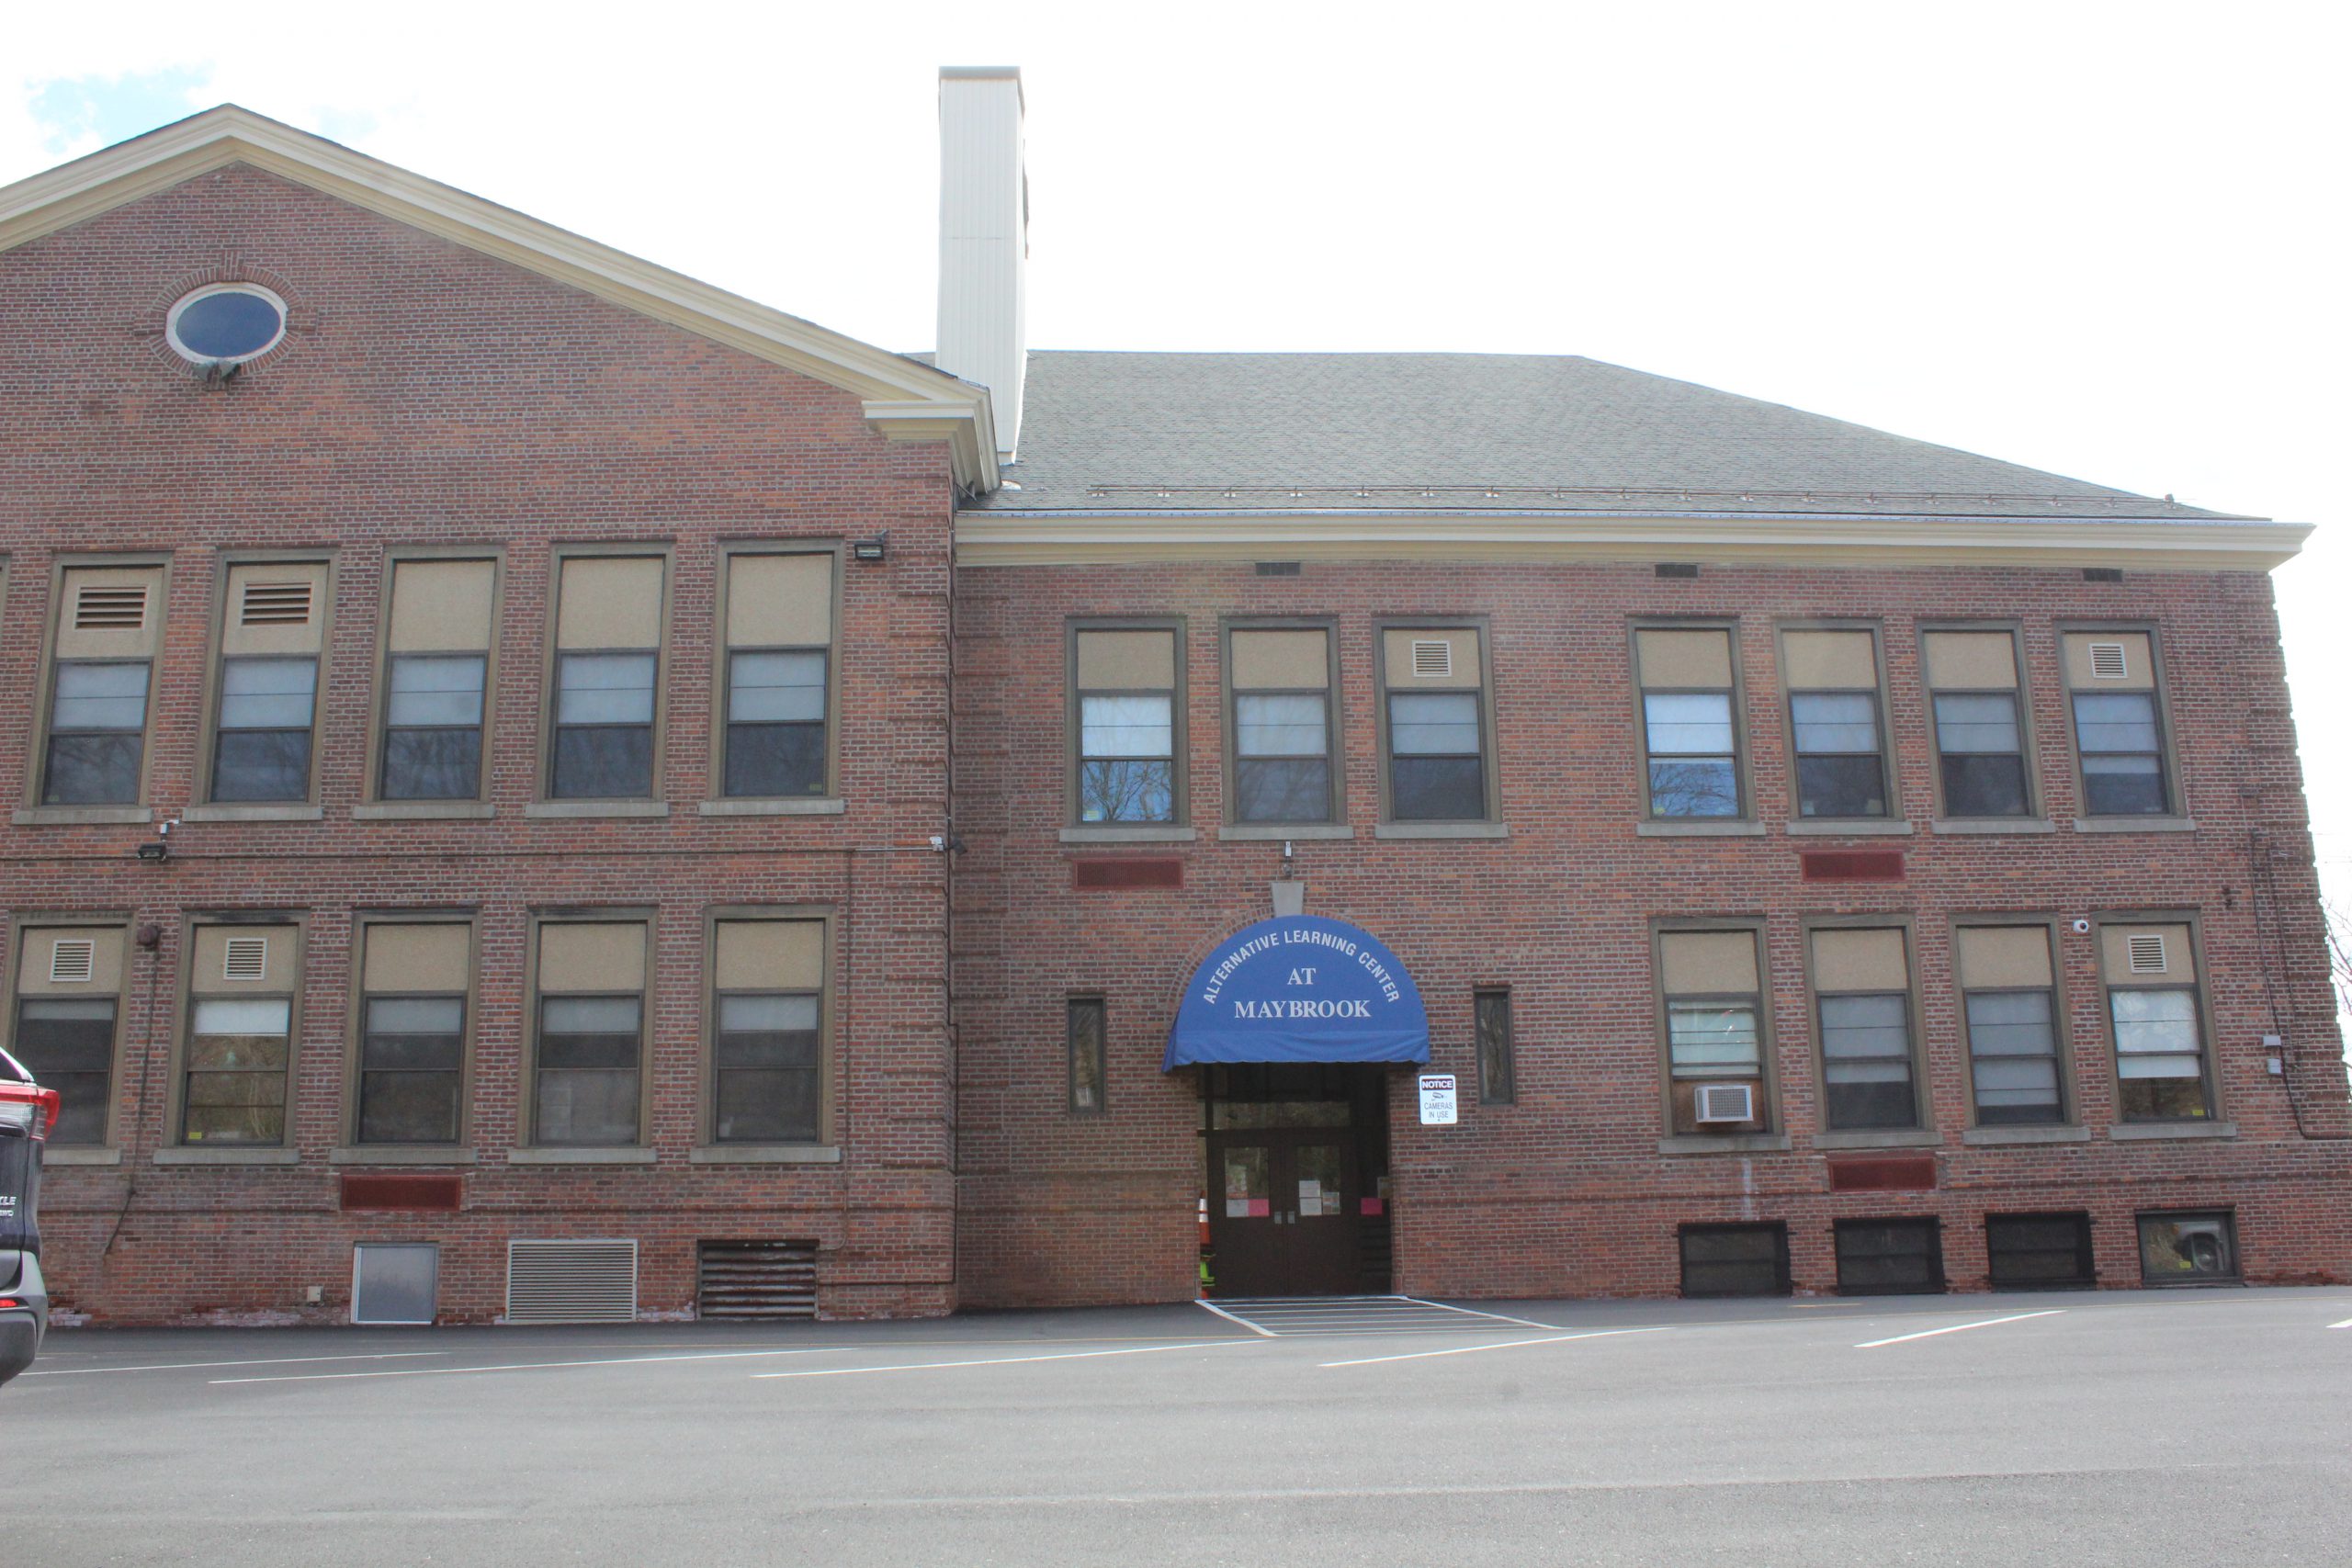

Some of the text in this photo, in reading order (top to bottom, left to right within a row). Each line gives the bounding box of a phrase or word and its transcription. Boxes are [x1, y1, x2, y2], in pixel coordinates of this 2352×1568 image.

[1203, 929, 1400, 1004] ALTERNATIVE LEARNING CENTER
[1287, 967, 1317, 986] AT
[1234, 999, 1372, 1019] MAYBROOK
[1422, 1080, 1453, 1089] NOTICE
